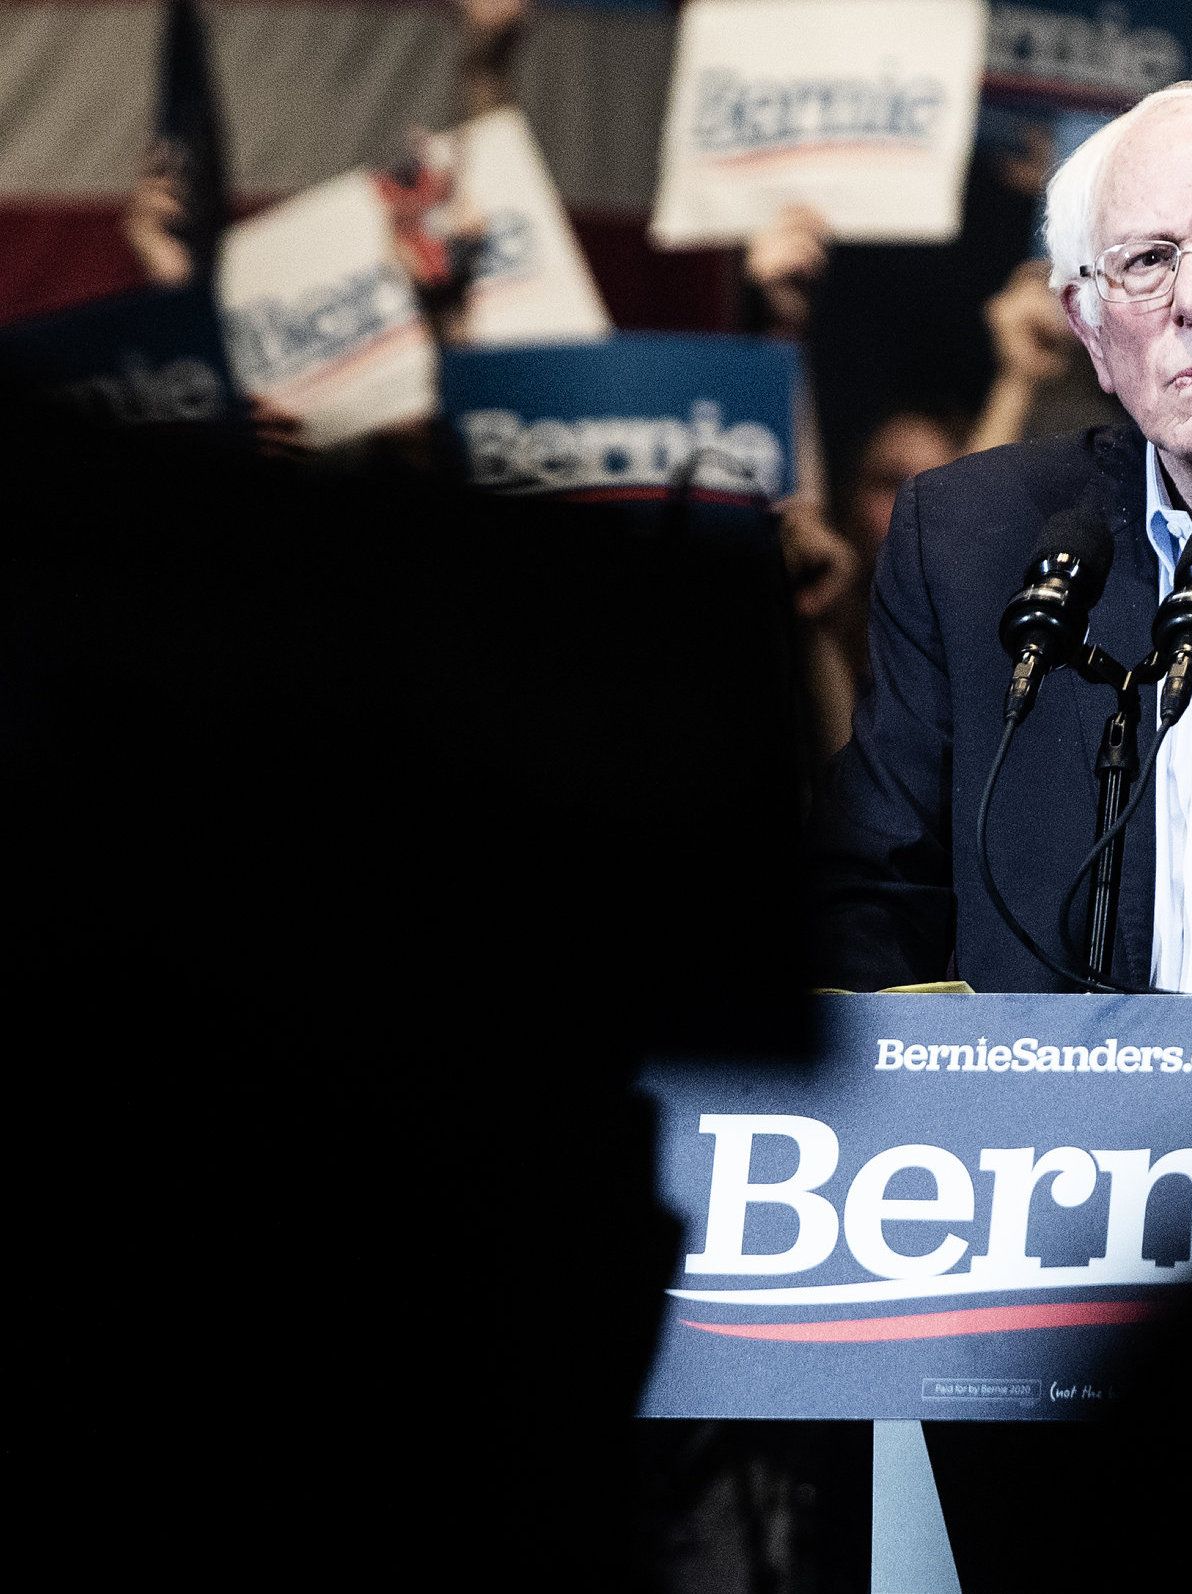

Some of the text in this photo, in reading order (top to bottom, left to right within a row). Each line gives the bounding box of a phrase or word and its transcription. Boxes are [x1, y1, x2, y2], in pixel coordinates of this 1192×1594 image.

[696, 58, 946, 152] Bernie
[463, 397, 782, 494] Bernie
[934, 1383, 954, 1394] Paid
[1009, 1384, 1031, 1395] 2020
[1049, 1381, 1077, 1401] (not
